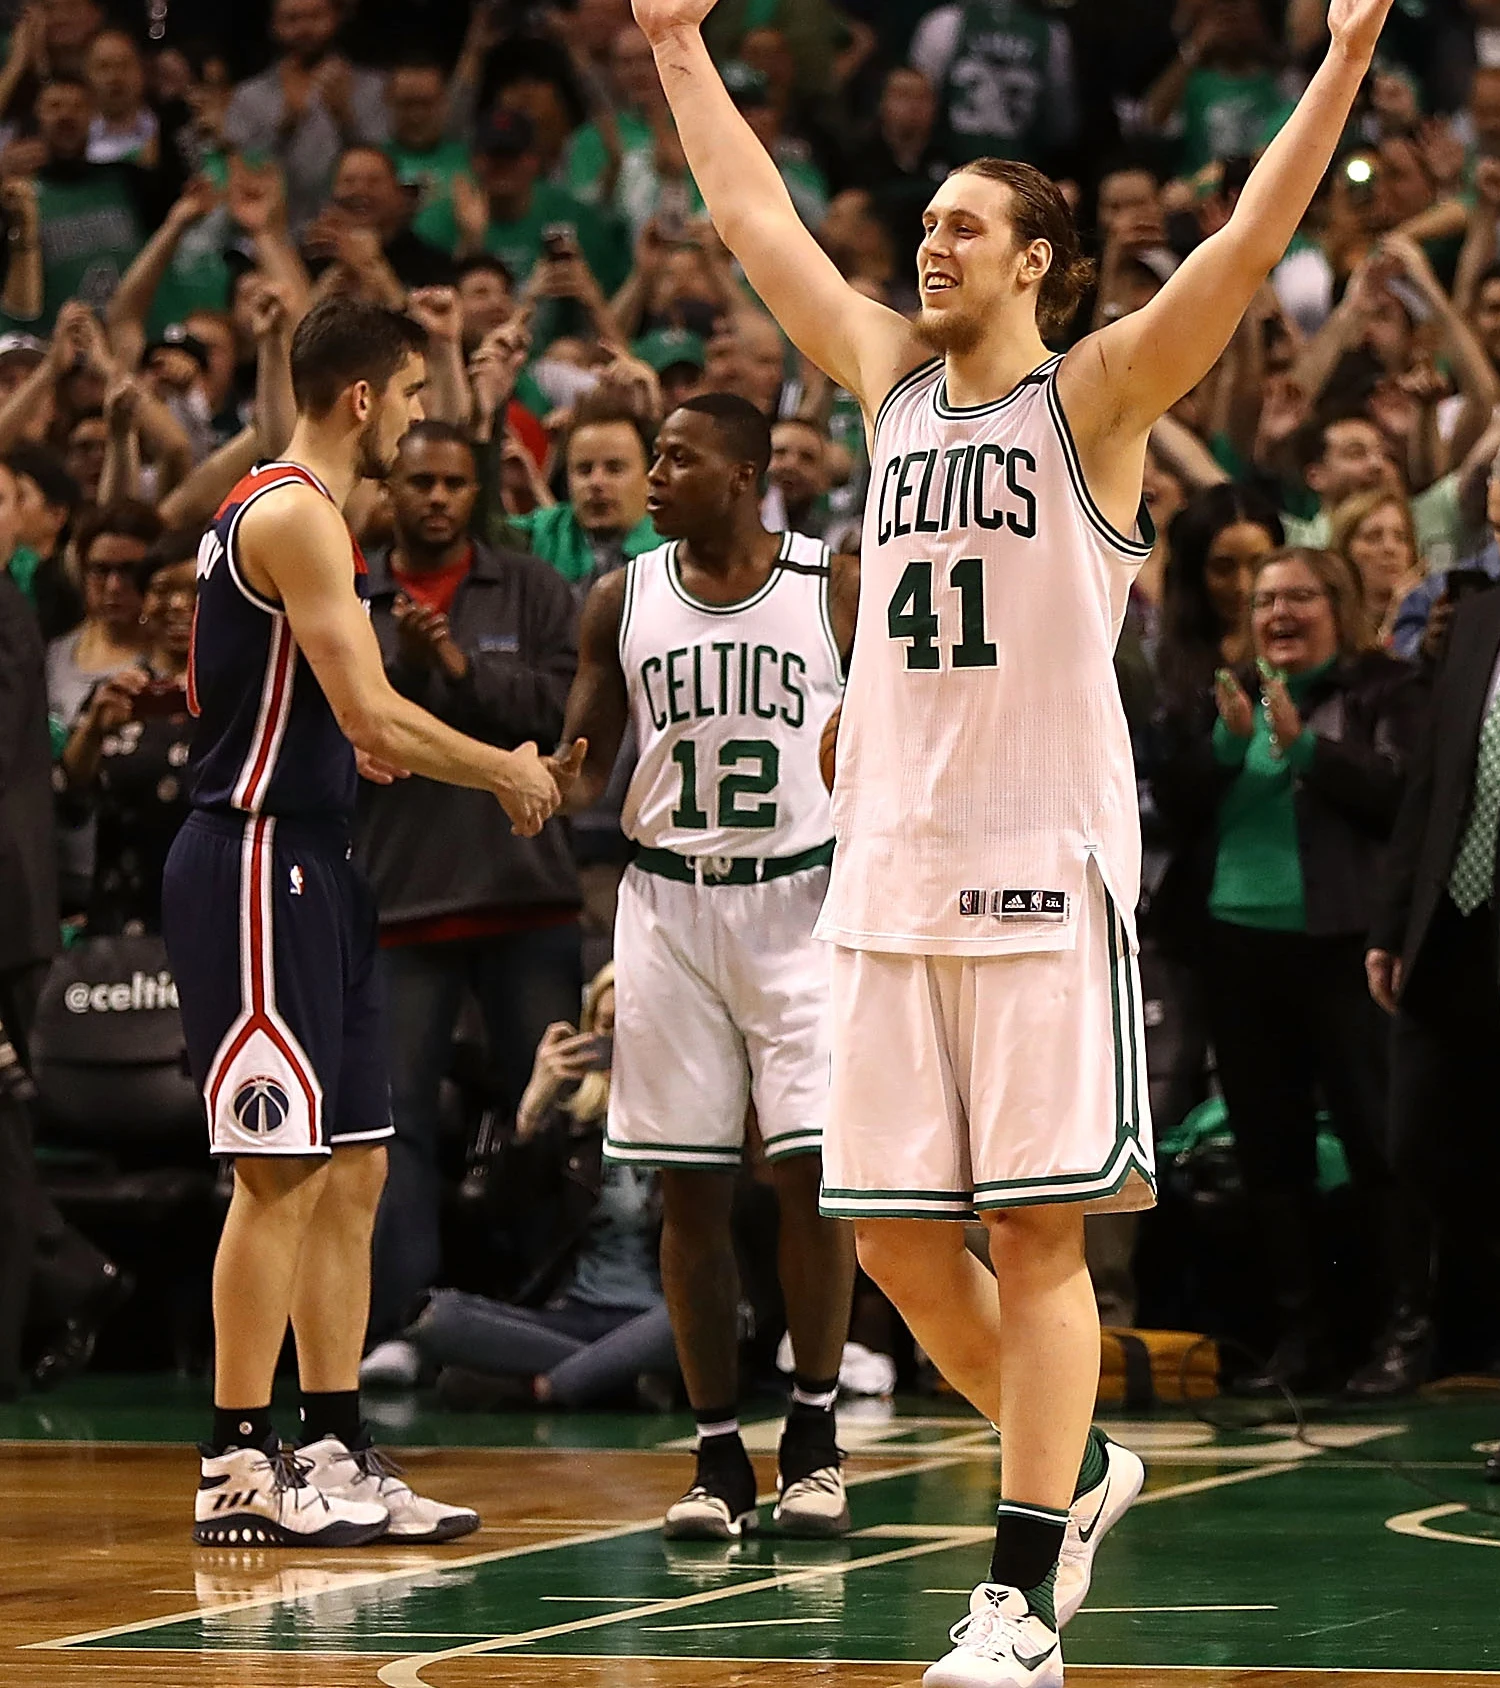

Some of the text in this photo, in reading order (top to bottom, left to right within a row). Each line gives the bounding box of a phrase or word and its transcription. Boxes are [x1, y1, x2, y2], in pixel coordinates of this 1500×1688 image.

[878, 443, 1037, 547] CELTICS
[887, 556, 1000, 670] 41
[641, 642, 806, 731] CELTICS
[671, 739, 780, 829] 12
[1045, 899, 1061, 908] 2XL
